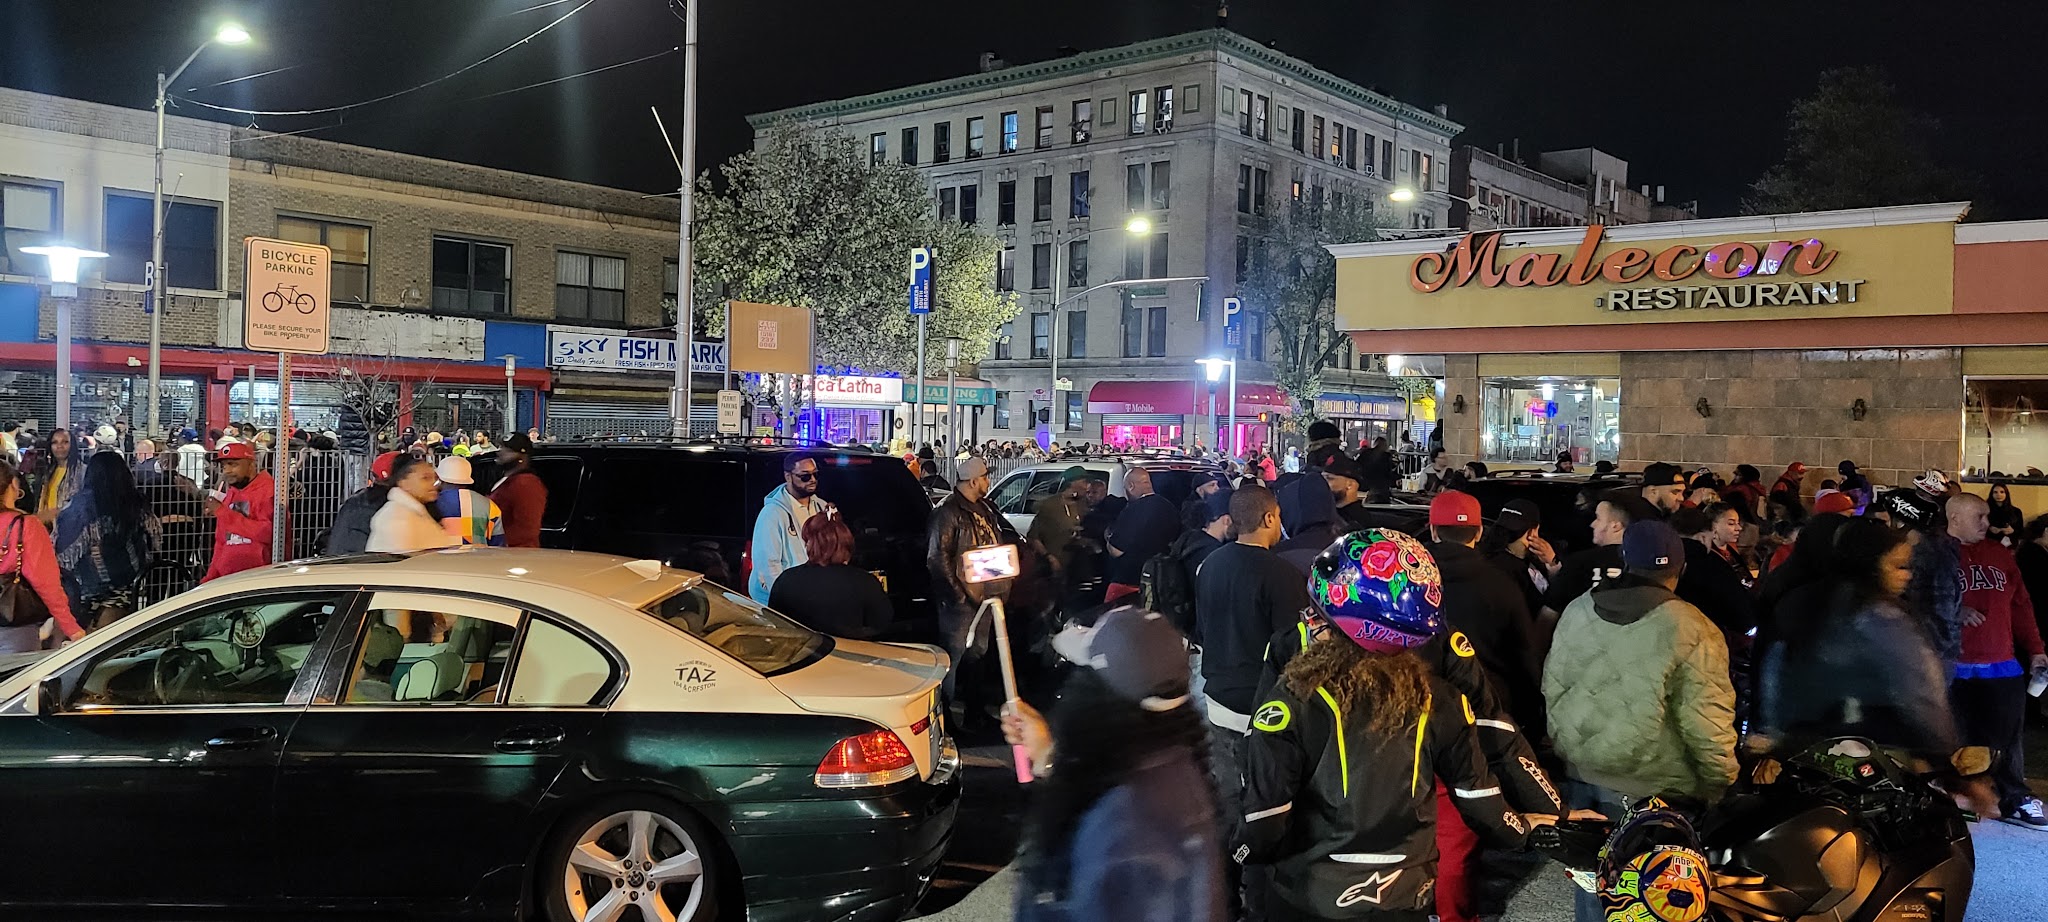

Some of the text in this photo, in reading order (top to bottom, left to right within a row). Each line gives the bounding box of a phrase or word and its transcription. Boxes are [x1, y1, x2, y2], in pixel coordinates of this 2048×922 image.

[261, 249, 317, 265] BICYCLE
[265, 262, 314, 276] PARKING
[911, 248, 929, 285] P
[1410, 225, 1838, 292] Malecon
[1608, 279, 1865, 311] RESTAURANT
[1223, 297, 1241, 327] P
[559, 337, 609, 355] SKY
[619, 339, 659, 361] FISH
[838, 378, 882, 394] Latina
[675, 667, 717, 683] TAZ
